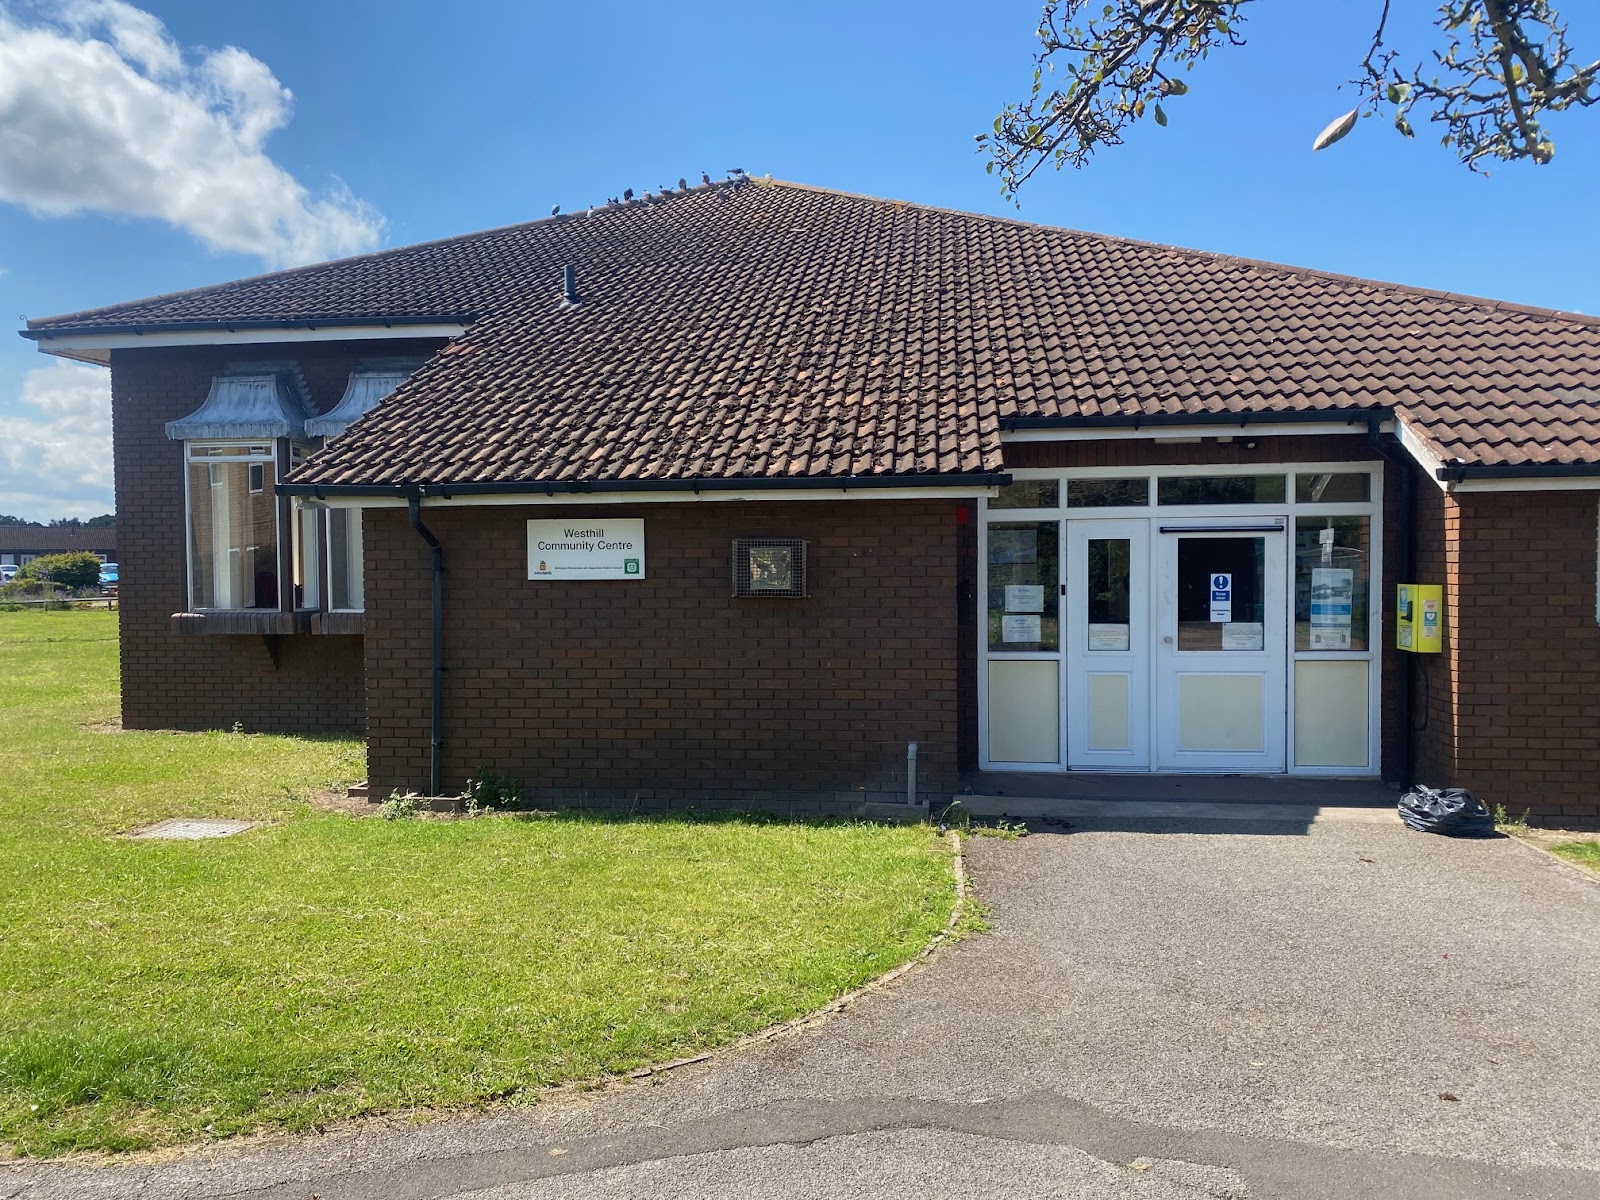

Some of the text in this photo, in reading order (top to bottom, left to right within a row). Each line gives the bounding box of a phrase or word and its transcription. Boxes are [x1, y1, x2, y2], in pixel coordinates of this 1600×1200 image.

[564, 528, 604, 538] Westhill
[538, 541, 632, 552] Community Centre
